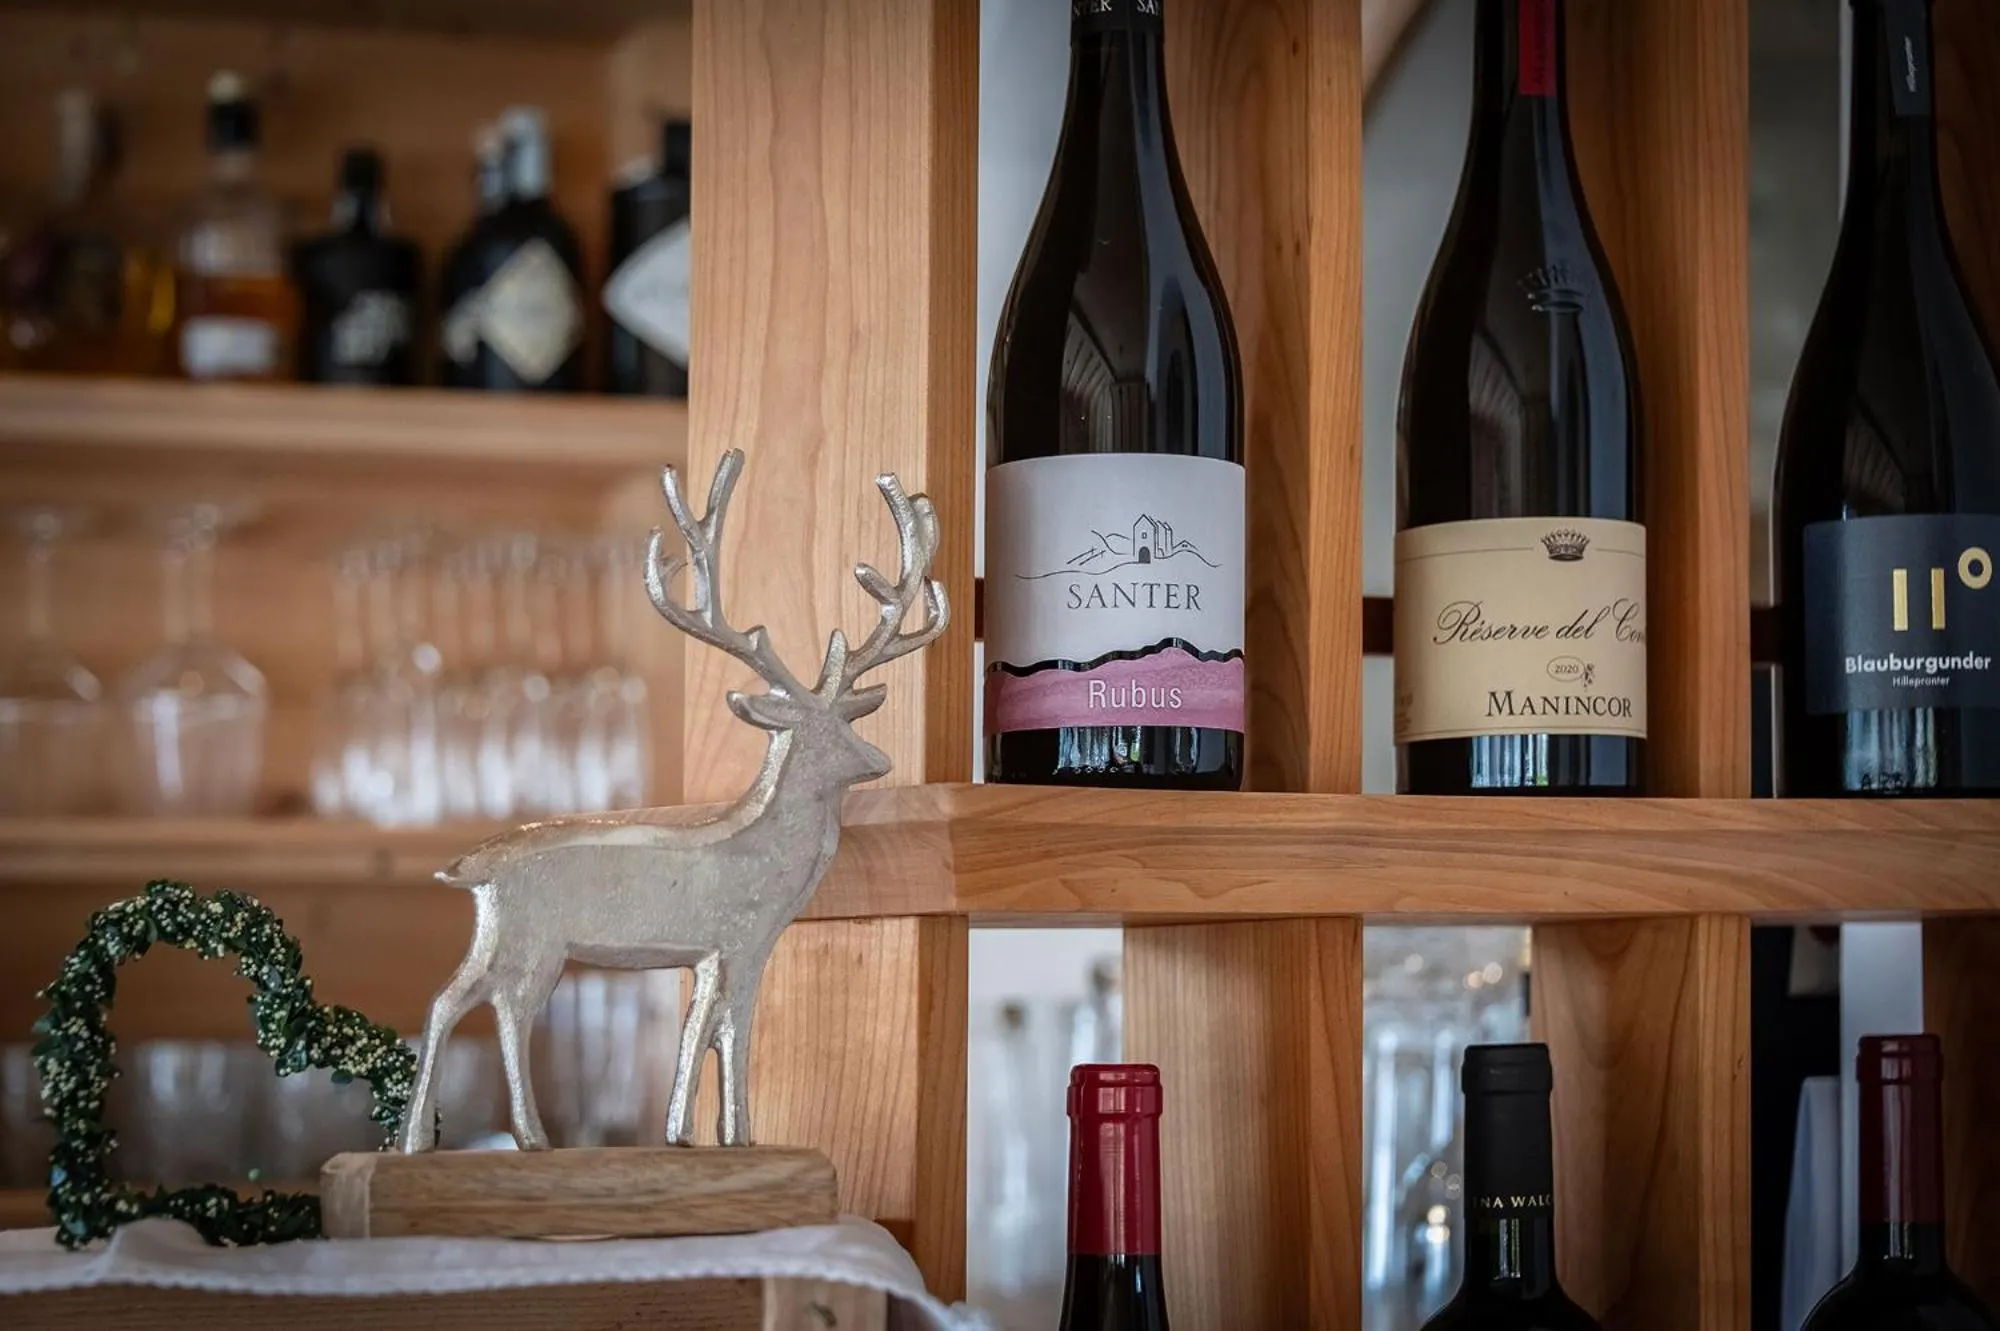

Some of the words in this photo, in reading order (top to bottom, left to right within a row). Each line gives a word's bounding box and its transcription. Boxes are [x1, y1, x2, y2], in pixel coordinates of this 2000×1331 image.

[1067, 582, 1202, 611] SANTER
[1432, 600, 1549, 646] Réserve
[1555, 605, 1611, 640] del
[1554, 662, 1579, 674] 2020
[1845, 650, 1993, 675] Blauburgunder
[1088, 679, 1183, 709] Rubus
[1485, 690, 1633, 718] MANINCOR
